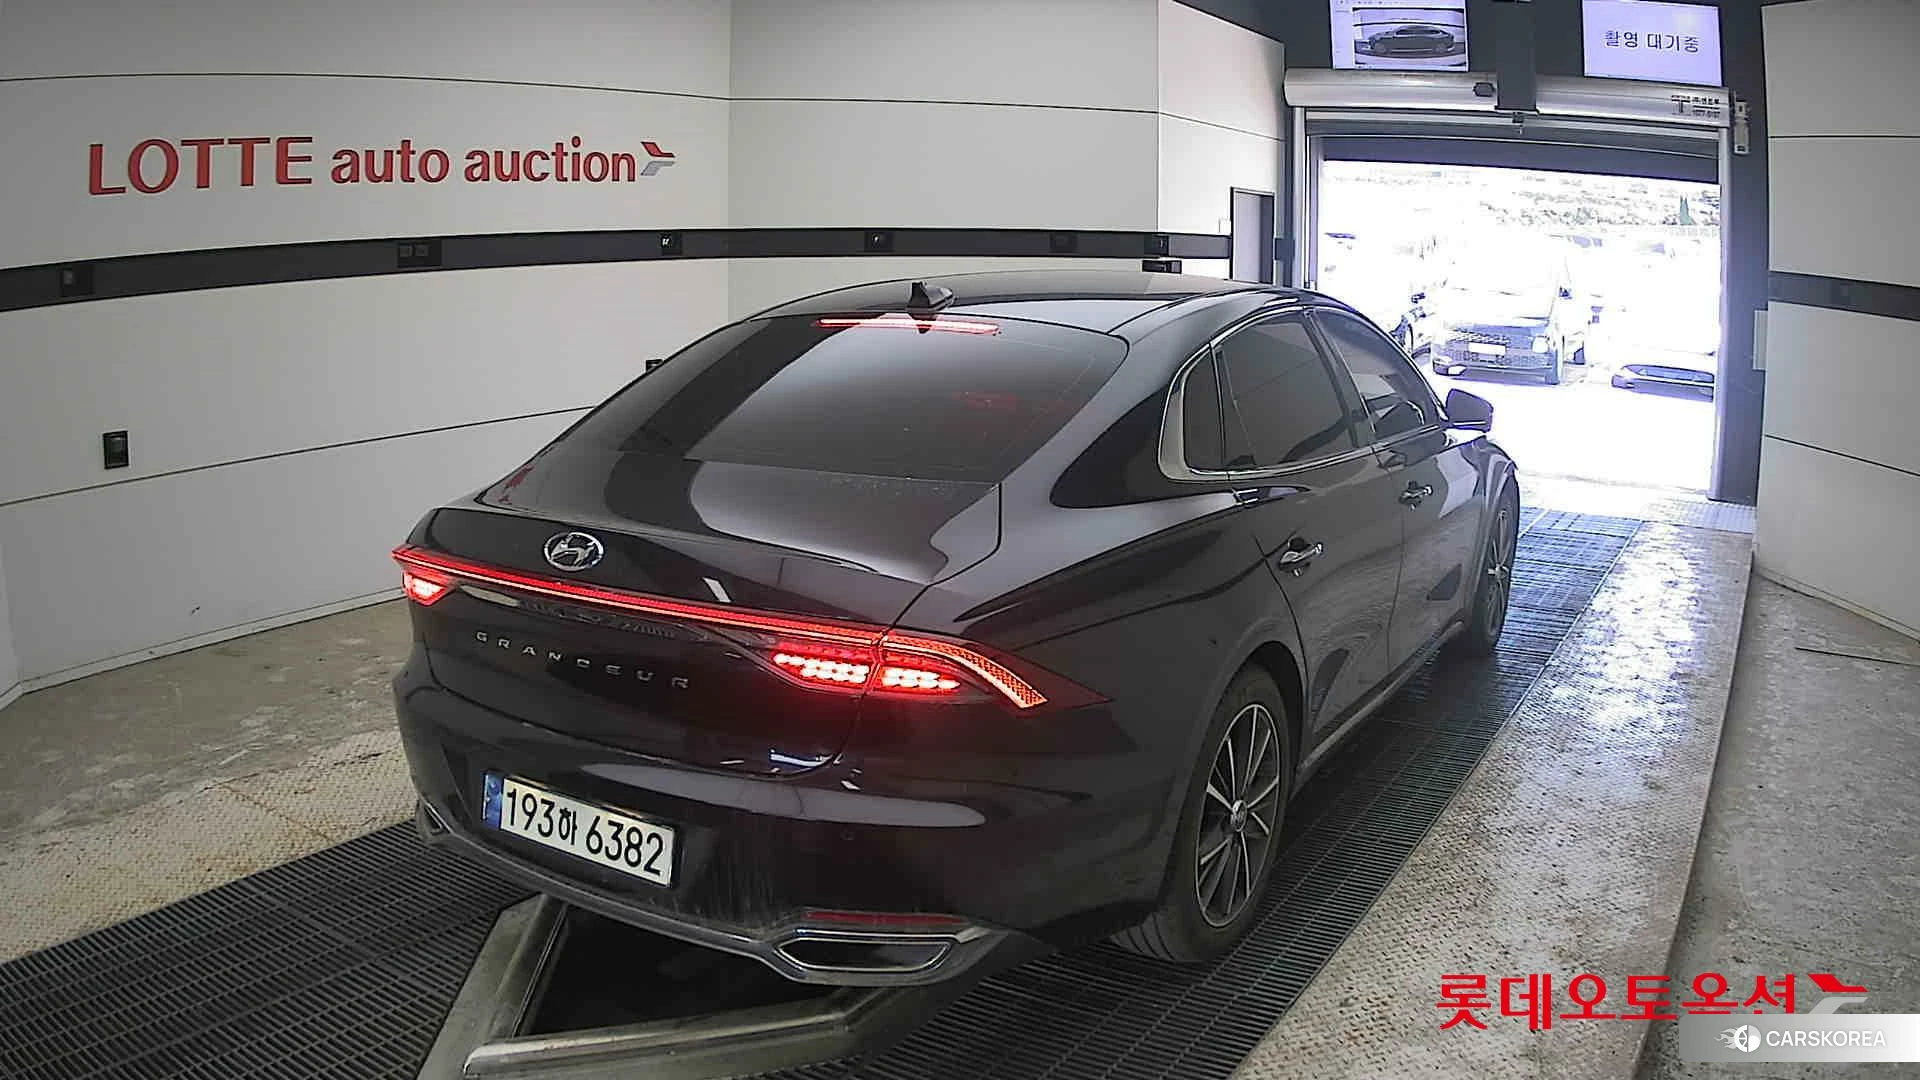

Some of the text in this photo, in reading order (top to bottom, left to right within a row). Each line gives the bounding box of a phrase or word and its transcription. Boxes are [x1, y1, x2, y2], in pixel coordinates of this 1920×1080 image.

[1647, 33, 1698, 53] 대기중
[89, 136, 636, 195] LOTTE auto auction
[507, 788, 664, 876] 193하 6382
